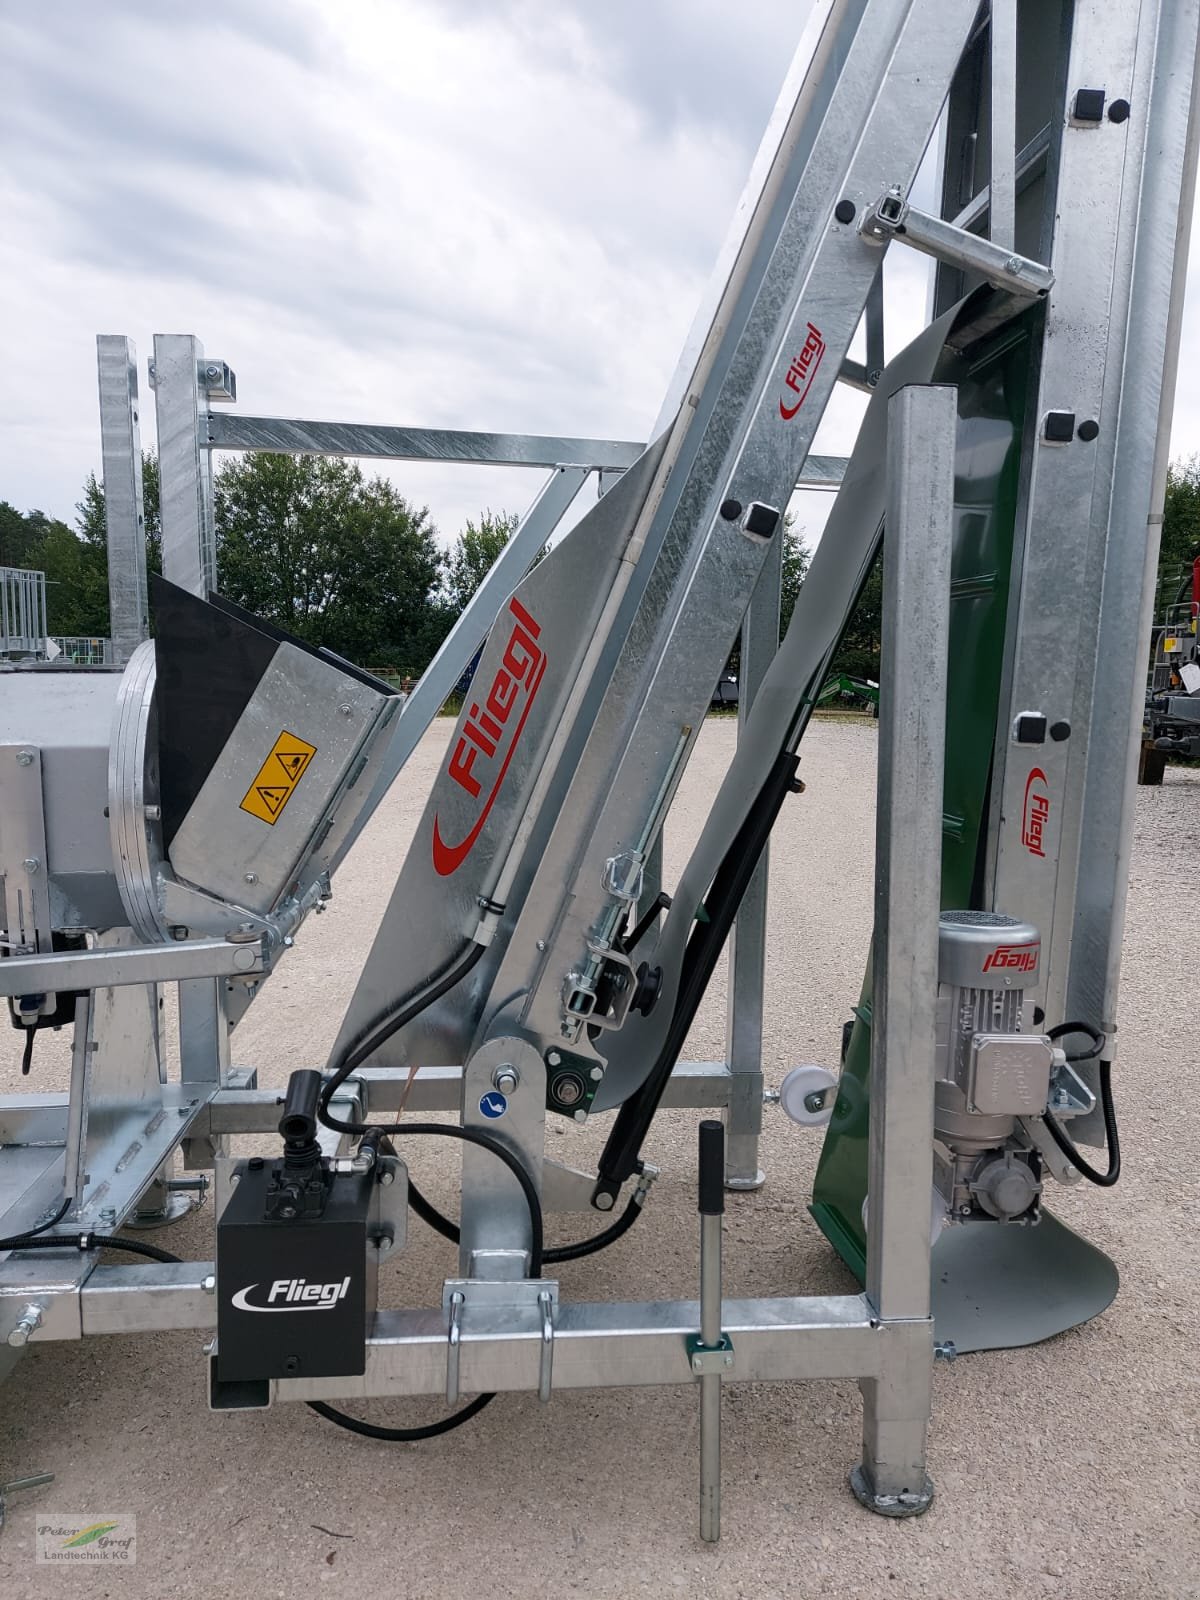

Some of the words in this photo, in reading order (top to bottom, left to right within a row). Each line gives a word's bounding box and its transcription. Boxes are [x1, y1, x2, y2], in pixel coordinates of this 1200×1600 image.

[785, 321, 823, 393] Fliegl
[448, 596, 542, 799] Fliegl
[1025, 794, 1049, 857] Fliegl
[982, 950, 1038, 972] Fliegl
[267, 1276, 351, 1305] Fliegl
